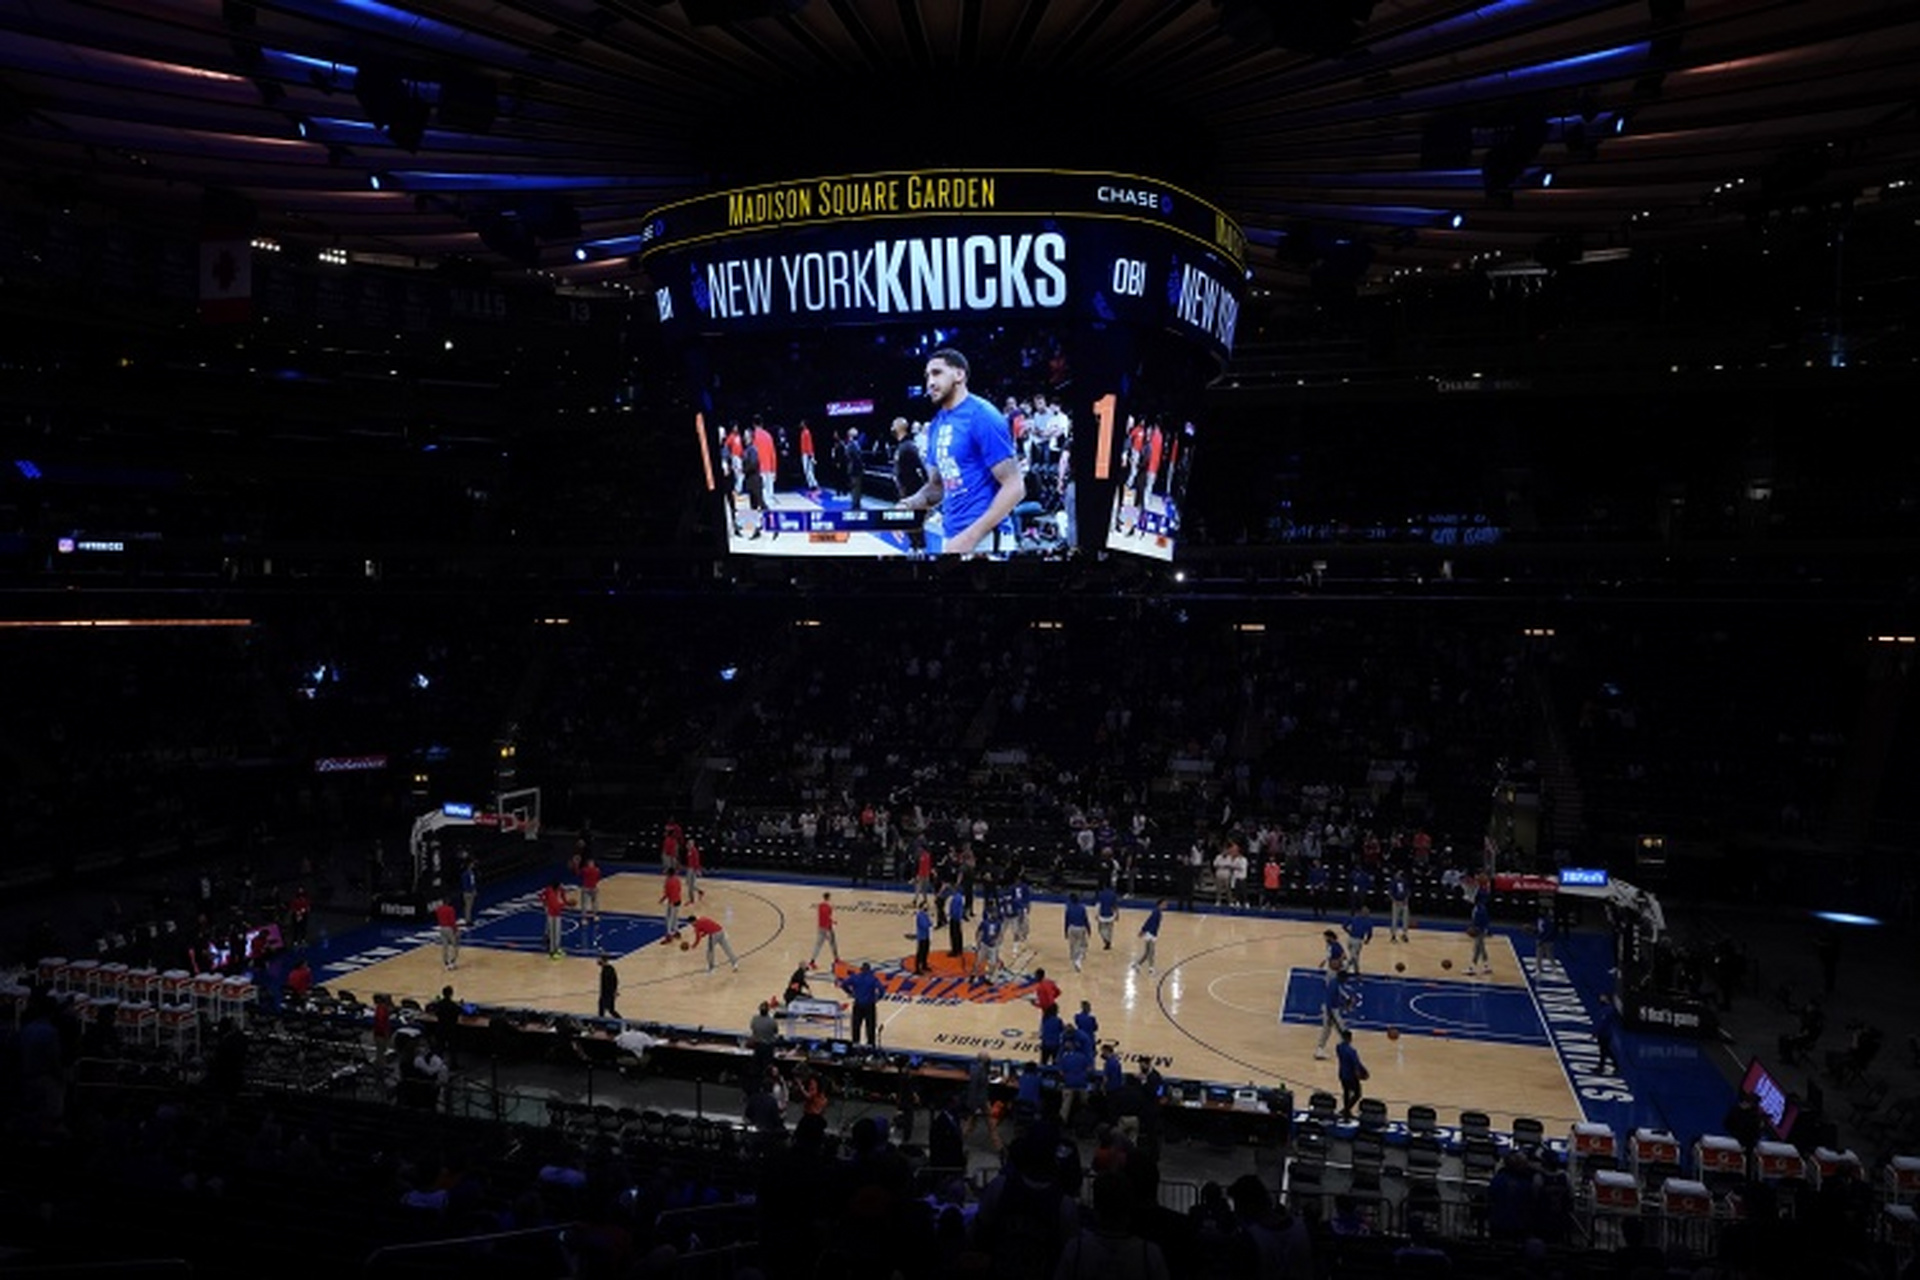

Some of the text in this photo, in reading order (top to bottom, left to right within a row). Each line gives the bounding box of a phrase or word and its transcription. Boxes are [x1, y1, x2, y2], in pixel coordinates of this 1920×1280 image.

[727, 174, 996, 227] MADISON SQUARE GARDEN
[1096, 185, 1159, 210] CHASE
[706, 231, 1068, 320] NEW YORK KNICKS
[1112, 256, 1148, 298] OBI
[1176, 263, 1220, 333] NEW
[1092, 393, 1117, 480] 1
[933, 1034, 1005, 1050] GARDEN
[1555, 1031, 1635, 1103] KNICKS
